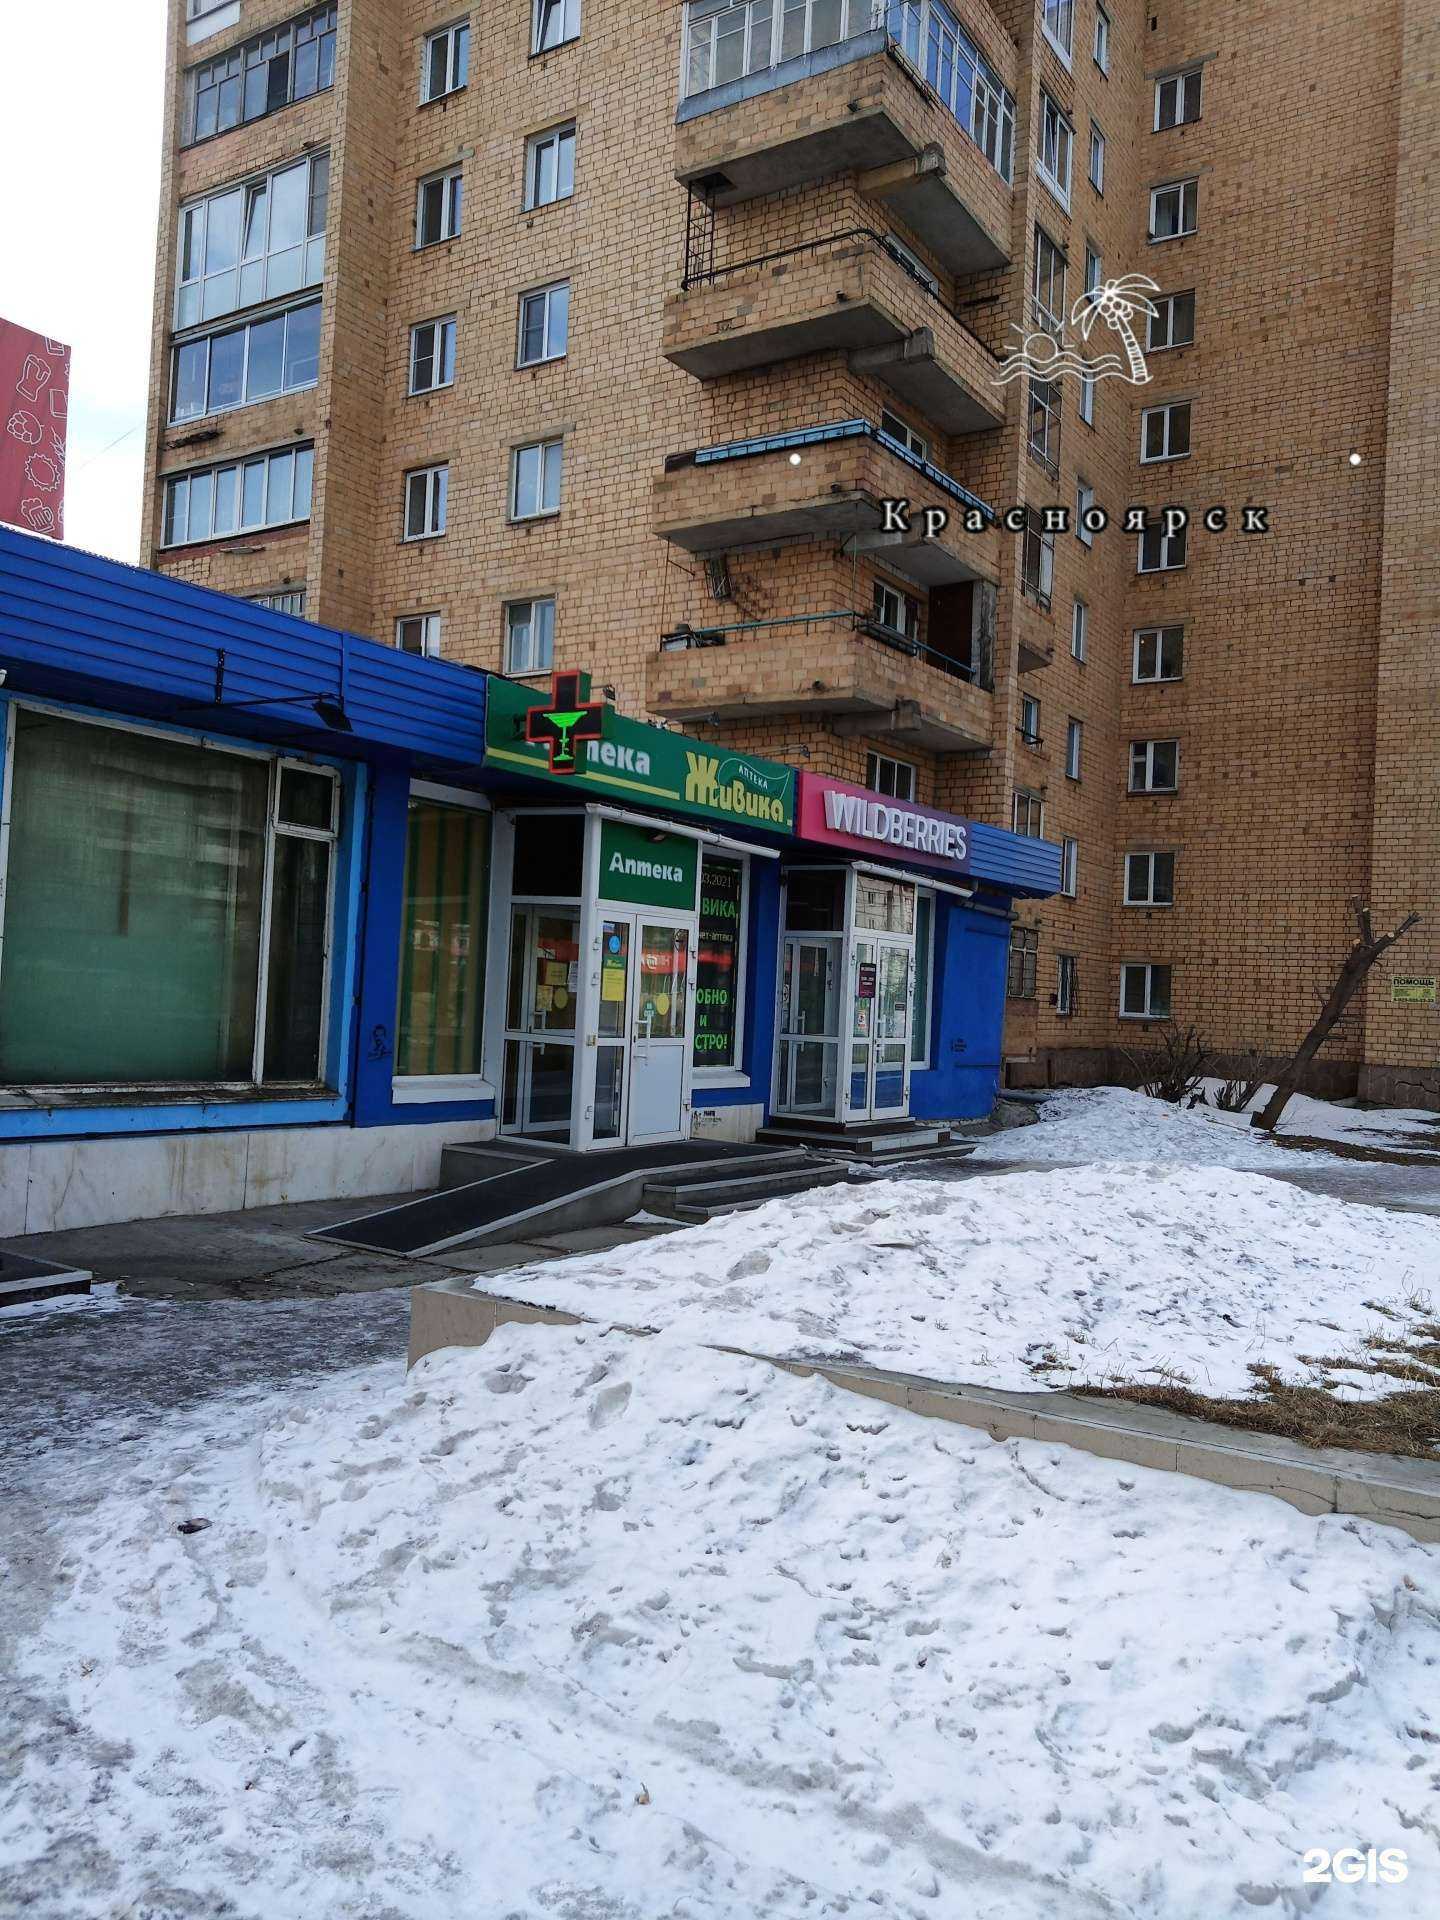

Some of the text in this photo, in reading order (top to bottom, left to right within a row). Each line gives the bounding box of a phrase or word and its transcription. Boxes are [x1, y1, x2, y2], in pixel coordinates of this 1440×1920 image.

[685, 752, 783, 823] Живика
[738, 764, 768, 789] АПТЕКА
[823, 790, 967, 860] WILDBERRIES
[609, 852, 683, 883] Аптека
[1393, 978, 1434, 986] ПОМОЩЬ
